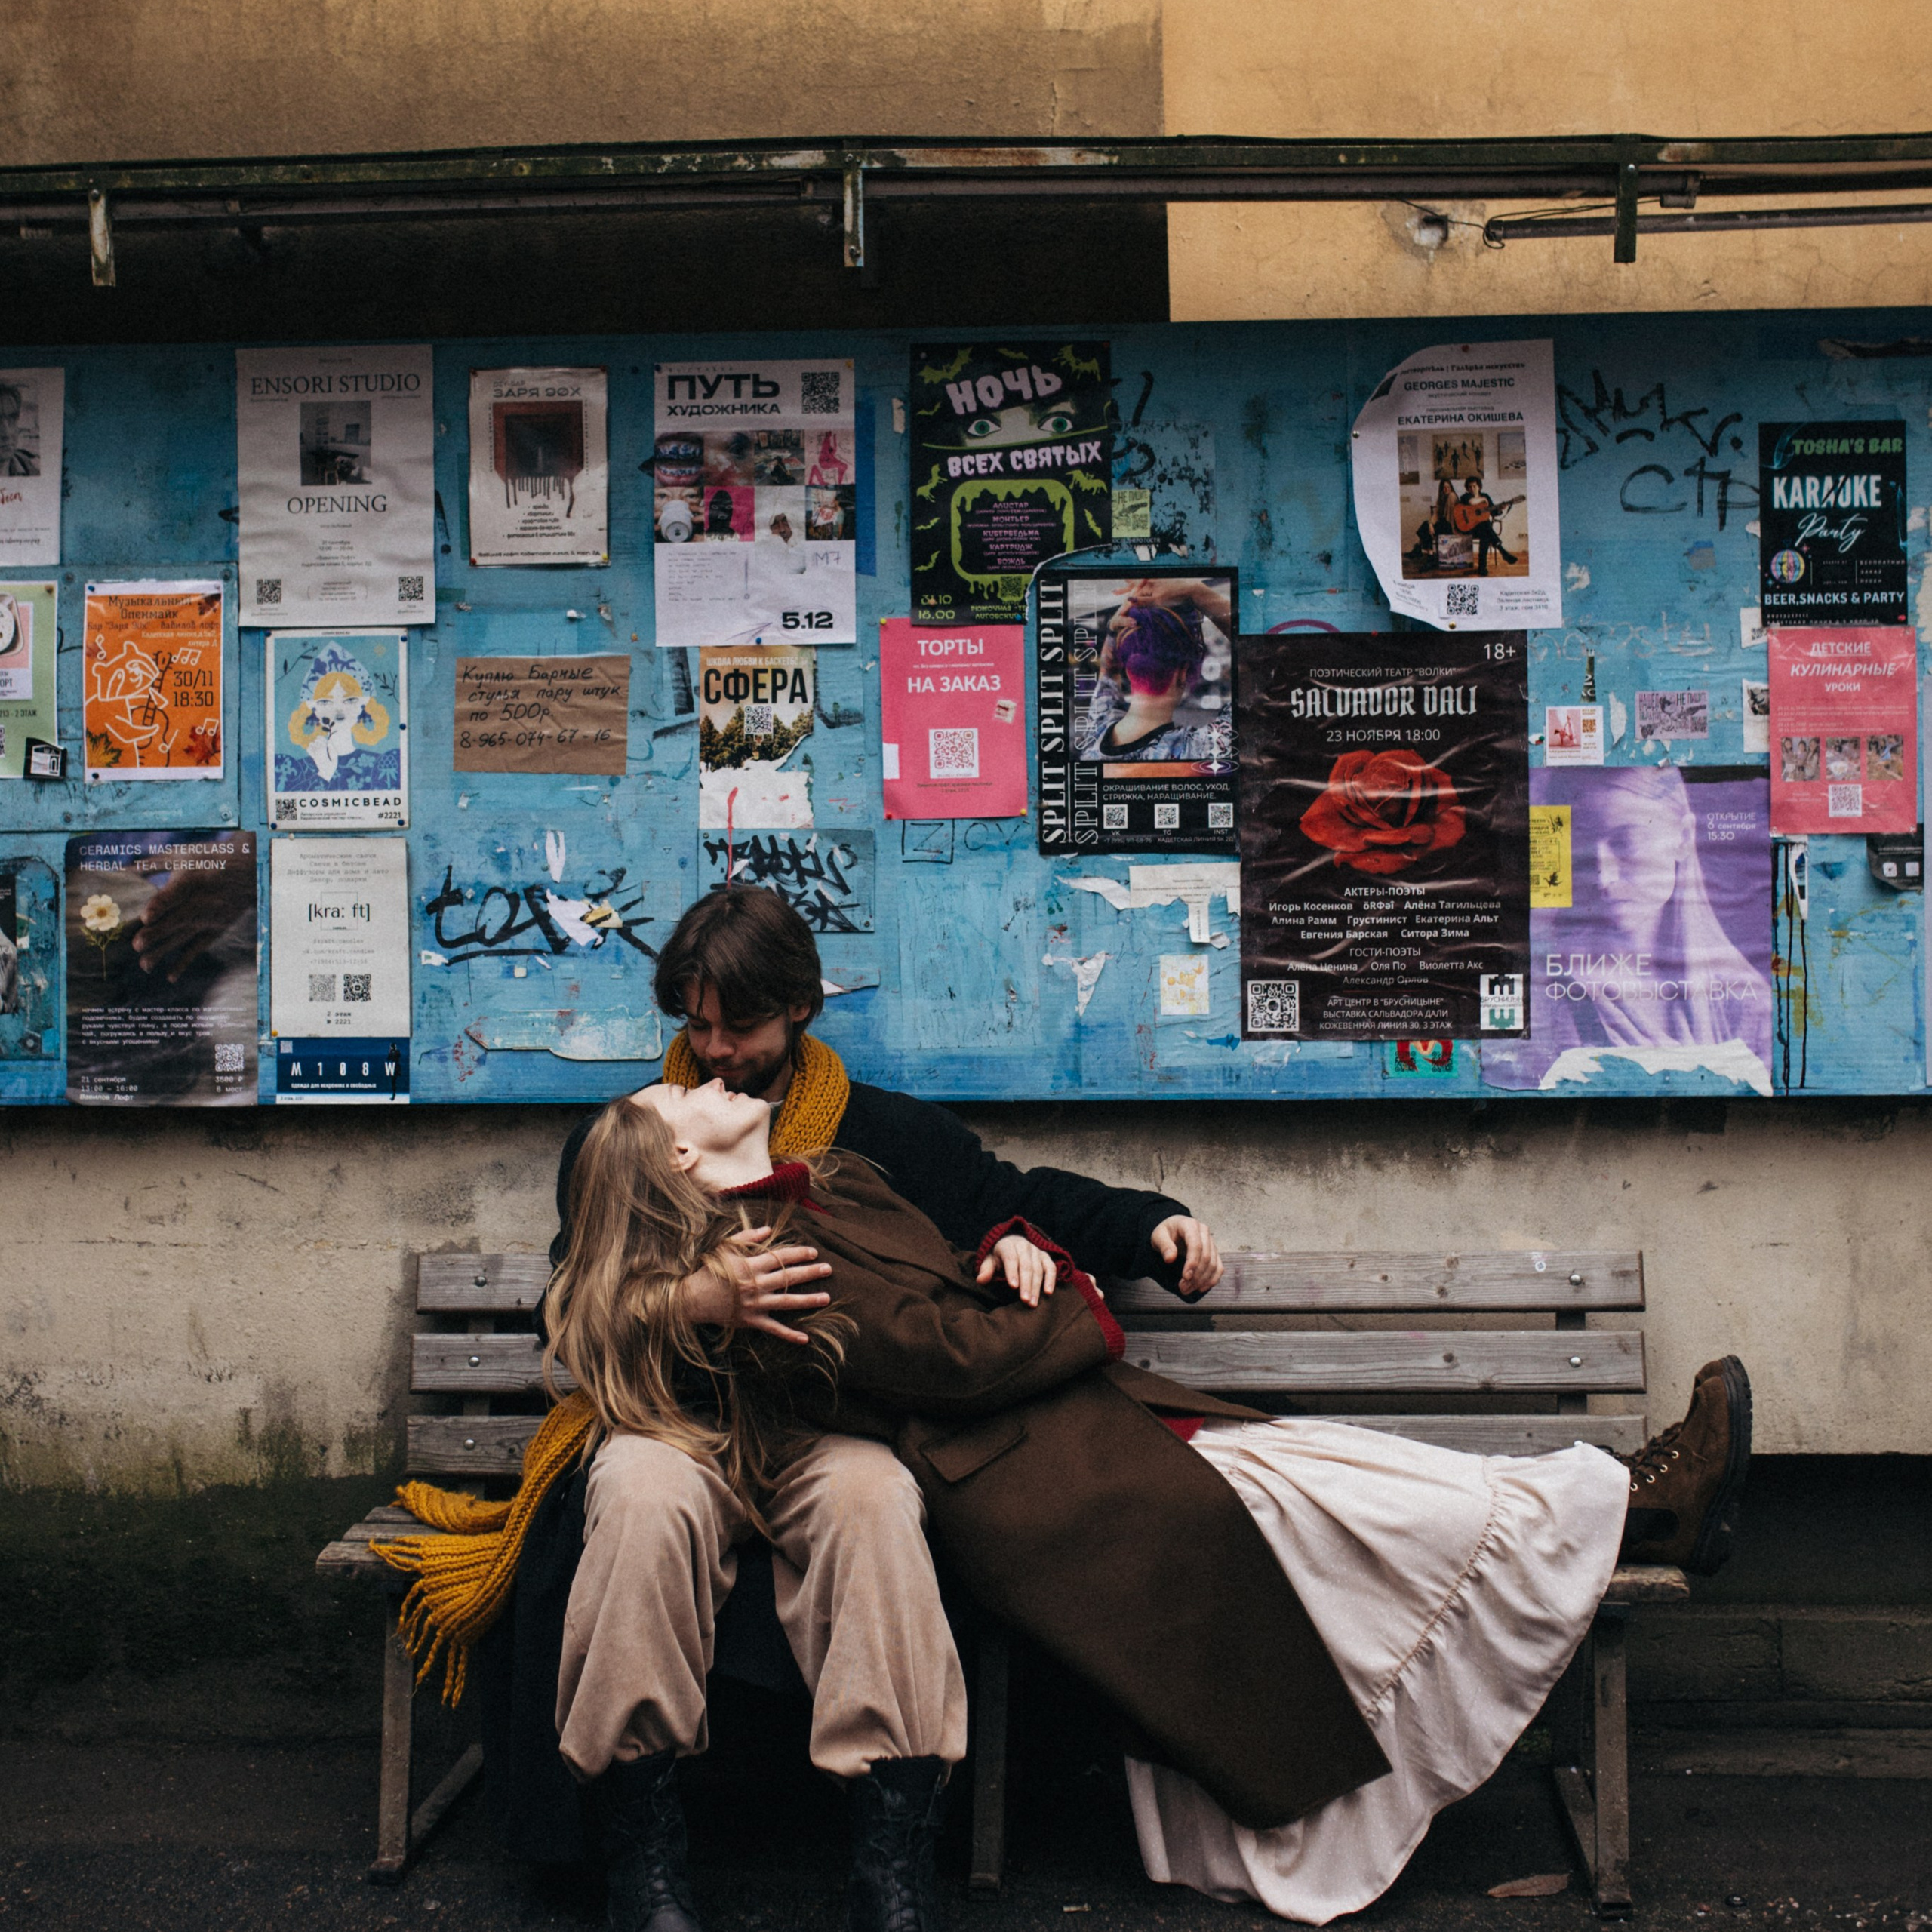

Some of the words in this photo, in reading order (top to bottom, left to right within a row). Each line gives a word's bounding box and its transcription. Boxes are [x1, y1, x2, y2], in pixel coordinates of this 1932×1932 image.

[251, 376, 334, 395] ENSORI
[339, 374, 421, 393] STUDIO
[667, 373, 781, 401] ПУТЬ
[946, 365, 1062, 415] НОЧЬ
[1404, 380, 1458, 392] GEORGES
[1461, 377, 1515, 389] MAJESTIC
[492, 387, 540, 398] ЗАРЯ
[667, 403, 781, 417] ХУДОЖНИКА
[1398, 415, 1465, 429] ЕКАТЕРИНА
[1468, 413, 1524, 426] ОКИШЕВА
[1792, 438, 1864, 455] TOSHA'S
[1869, 437, 1903, 454] BAR
[947, 451, 1004, 478] ВСЕХ
[1010, 441, 1103, 471] СВЯТЫХ
[1773, 475, 1881, 509] KARAOKE
[287, 495, 388, 515] OPENING
[1794, 512, 1869, 553] Party
[109, 595, 192, 608] Музыкальный
[1850, 592, 1860, 604] &
[1863, 590, 1904, 604] PARTY
[121, 608, 180, 619] Опенмайк
[782, 611, 833, 629] 5.12
[918, 609, 955, 620] 18.00
[1040, 580, 1064, 663] SPLIT
[917, 638, 984, 657] ТОРТЫ
[1484, 643, 1516, 660] 18+
[1810, 641, 1872, 657] ДЕТСКИЕ
[706, 657, 731, 666] ШКОЛА
[732, 657, 758, 666] ЛЮБВИ
[758, 657, 764, 666] К
[463, 665, 515, 689] Куплю
[528, 663, 594, 686] Барные
[1309, 667, 1383, 678] ПОЭТИЧЕСКИЙ
[1385, 667, 1413, 677] ТЕАТР
[1414, 666, 1457, 676] "ВОЛКИ"
[1790, 662, 1897, 678] КУЛИНАРНЫЕ
[174, 669, 214, 689] 30/11
[703, 668, 808, 705] СФЕРА
[907, 676, 936, 693] НА
[940, 674, 1002, 692] ЗАКАЗ
[468, 685, 521, 706] стулья
[536, 688, 573, 706] пару
[583, 685, 621, 700] штук
[1824, 682, 1861, 694] УРОКИ
[174, 691, 214, 707] 18:30
[1290, 687, 1417, 718] SALVADOR
[1423, 685, 1478, 717] DALI
[469, 710, 488, 722] по
[499, 703, 555, 724] 500р.
[1040, 669, 1065, 752] SPLIT
[1074, 668, 1099, 752] SPLIT
[1326, 729, 1343, 742] 23
[1346, 729, 1402, 741] НОЯБРЯ
[1405, 728, 1441, 740] 18:00
[1103, 784, 1169, 792] ОКРАШИВАНИЕ
[1171, 783, 1204, 792] ВОЛОС,
[299, 797, 401, 808] COSMICBEAD
[1042, 761, 1067, 844] SPLIT
[1074, 761, 1100, 844] SPLIT
[1103, 792, 1146, 801] СТРИЖКА,
[1146, 792, 1217, 801] НАРАЩИВАНИЕ.
[1706, 812, 1757, 821] ОТКРЫТИЕ
[1707, 820, 1715, 830] 6
[1717, 822, 1757, 831] сентября
[1707, 831, 1735, 841] 15:30
[79, 844, 142, 855] CERAMICS
[149, 842, 235, 855] MASTERCLASS
[242, 843, 250, 854] &
[80, 861, 126, 872] HERBAL
[134, 860, 157, 870] TEA
[165, 859, 226, 870] CEREMONY
[1344, 887, 1425, 897] АКТЕРЫ-ПОЭТЫ
[1269, 902, 1300, 913] Игорь
[1303, 902, 1353, 912] Косенков
[1404, 900, 1436, 910] Алёна
[1438, 900, 1501, 912] Тагильцева
[1271, 916, 1305, 925] Алина
[1307, 916, 1337, 926] Рамм
[1347, 915, 1407, 927] Грустинист
[1415, 915, 1471, 926] Екатерина
[1472, 914, 1499, 923] Альт
[1300, 930, 1343, 940] Евгения
[1345, 929, 1388, 940] Барская
[1401, 928, 1438, 940] Ситора
[1441, 928, 1469, 938] Зима
[1349, 947, 1421, 957] ГОСТИ-ПОЭТЫ
[1320, 962, 1358, 972] Ценина
[1371, 961, 1391, 971] Оля
[1392, 961, 1407, 971] По
[1419, 959, 1465, 971] Виолетта
[1466, 960, 1484, 970] Акс
[1546, 953, 1652, 977] БЛИЖЕ
[1343, 975, 1395, 986] Александр
[1396, 974, 1428, 985] Орлов
[1545, 980, 1758, 1001] ФОТОВЫСТАВКА
[1327, 998, 1343, 1007] АРТ
[1344, 998, 1371, 1008] ЦЕНТР
[1380, 997, 1444, 1007] "БРУСНИЦЫНЕ"
[1323, 1009, 1366, 1019] ВЫСТАВКА
[1367, 1009, 1423, 1018] САЛЬВАДОРА
[1424, 1008, 1448, 1018] ДАЛИ
[1319, 1021, 1375, 1030] КОЖЕВЕННАЯ
[1377, 1021, 1408, 1029] ЛИНИЯ
[1409, 1021, 1421, 1031] 30,
[1429, 1021, 1453, 1029] ЭТАЖ
[94, 1075, 126, 1084] сентября
